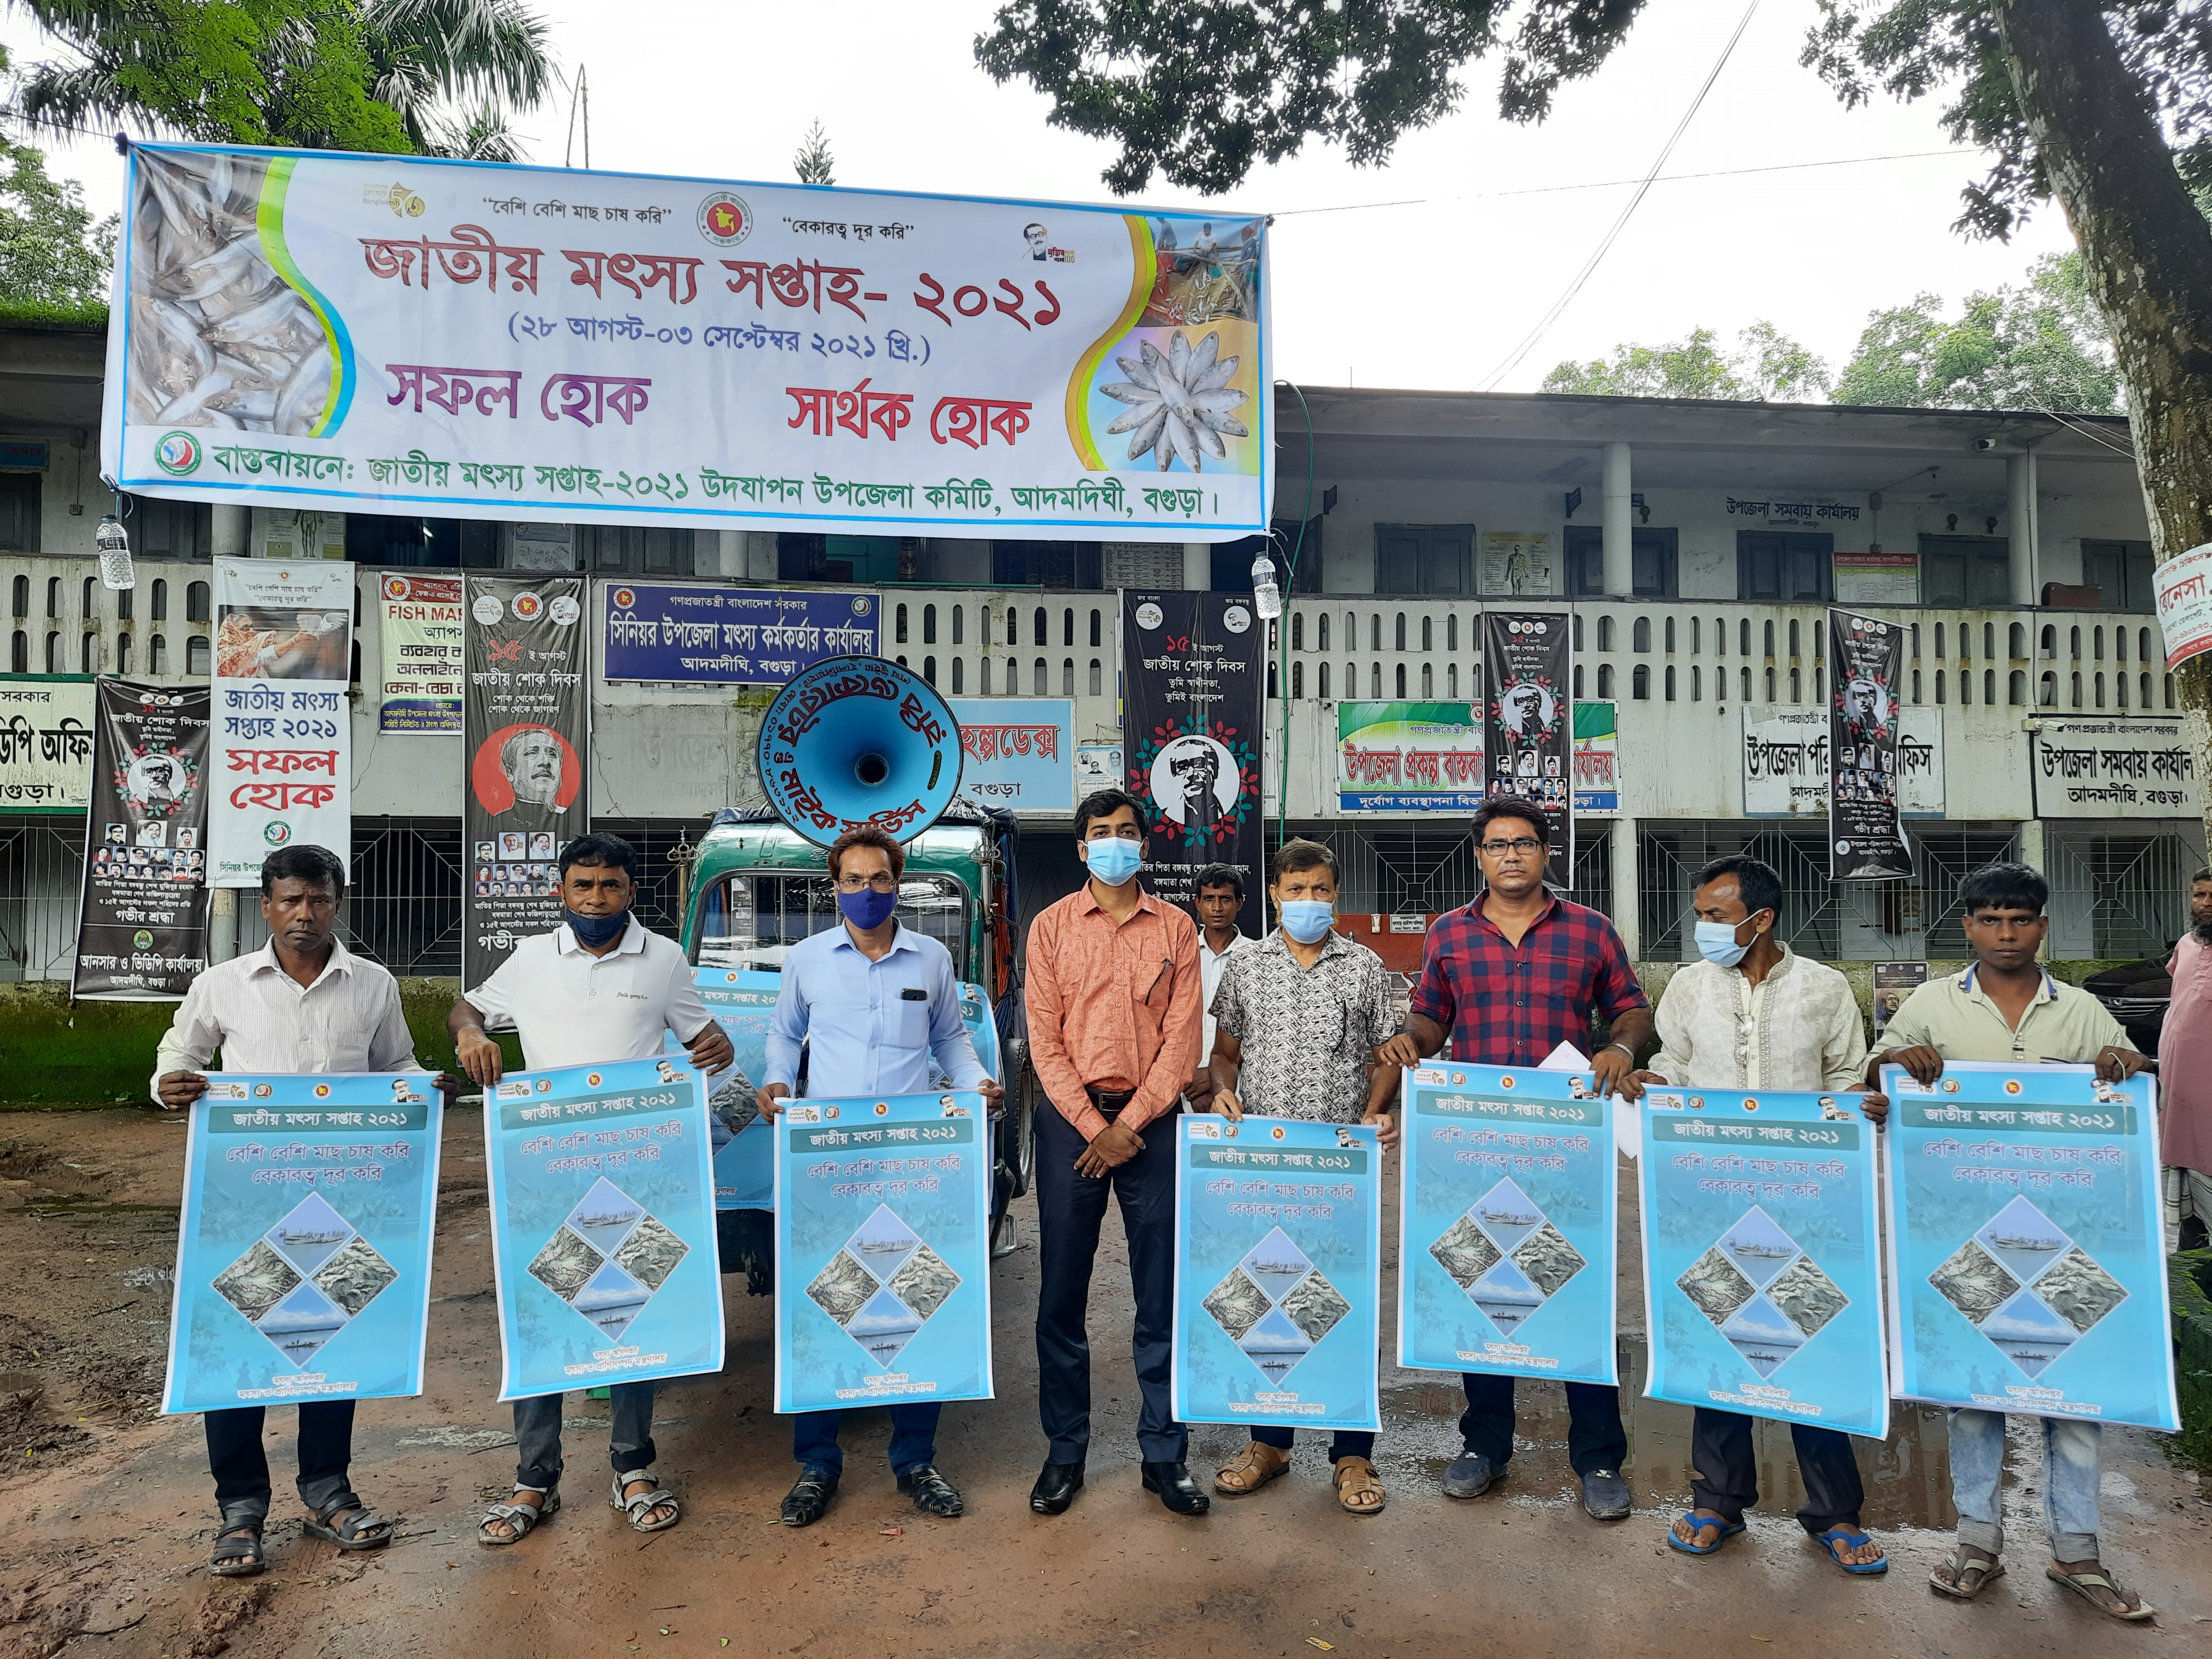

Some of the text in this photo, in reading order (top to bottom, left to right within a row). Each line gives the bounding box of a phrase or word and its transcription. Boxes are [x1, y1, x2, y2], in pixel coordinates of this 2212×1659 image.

[483, 196, 672, 225] “বেশি বেশি মাছ চাষ করি”
[700, 194, 749, 222] গণপ্রজাতন্ত্রী বাংলাদেশ
[783, 215, 914, 241] “বেকারত্ব দূর করি”
[713, 235, 741, 244] সরকার
[358, 225, 1061, 331] জাতীয় মৎস্য সপ্তাহ- ২০২১
[508, 310, 556, 341] (২৮
[569, 314, 692, 346] আগস্ট-০৩
[704, 321, 801, 354] সেপ্টেম্বর
[812, 332, 876, 360] ২০২১
[386, 364, 651, 428] সফল হোক
[786, 378, 1032, 450] সার্থক হোক
[212, 444, 353, 480] বাস্তবায়নে:
[366, 450, 448, 487] জাতীয়
[459, 462, 523, 491] মৎস্য
[535, 465, 688, 502] সপ্তাহ-২০২১
[702, 467, 803, 505] উদযাপন
[814, 473, 914, 510] উপজেলা
[925, 479, 1002, 516] কমিটি,
[1011, 477, 1134, 518] আদমদিঘী,
[1726, 497, 1860, 520] উপজেলা সমবায় কার্যালয়
[388, 606, 425, 620] FISH
[670, 595, 807, 611] গণপ্রজাতন্ত্রী বাংলাদেশ সরকার
[609, 611, 874, 655] সিনিয়র উপজেলা মৎস্য কর্মকর্তার কার্যালয়
[1166, 634, 1223, 653] ১৫ ই আগস্ট
[400, 645, 448, 659] ব্যবহার
[489, 639, 567, 662] ১৫ ই আগস্ট
[680, 654, 753, 675] আদমদীঘি,
[1142, 655, 1246, 674] জাতীয় শোক দিবস
[385, 682, 453, 694] কেনা-বেচা
[471, 667, 582, 688] জাতীয় শোক দিবস
[1169, 676, 1221, 690] তুমি স্বাধীনতা,
[1, 691, 51, 704] সরকার
[224, 684, 340, 713] জাতীয় মৎস্য
[493, 693, 555, 704] শোক থেকে শক্তি
[1165, 691, 1225, 704] তুমিই বাংলাদেশ
[109, 712, 210, 728] জাতীয় শোক দিবস
[488, 705, 559, 715] শোক থেকে জাগরণ
[778, 675, 899, 748] ডেকোরেটর
[225, 716, 337, 741] সপ্তাহ ২০২১
[1409, 722, 1464, 736] গণপ্রজাতন্ত্রী
[2118, 725, 2152, 734] বাংলাদেশ
[2154, 726, 2179, 736] সরকার
[959, 724, 1061, 764] হল্পডেক্স
[226, 749, 340, 776] সফল
[1343, 739, 1441, 787] উপজেলা প্রকল্প
[2041, 740, 2194, 781] উপজেলা সমবায় কার্যাল
[230, 783, 336, 811] হোক
[780, 767, 838, 830] মাইক
[969, 782, 1022, 798] বগুড়া
[1359, 795, 1455, 809] দুর্যোগ ব্যবস্থাপনা
[115, 908, 176, 924] গভীর শ্রদ্ধা
[79, 952, 204, 973] আনসার ও ভিডিপি কার্যালয়
[232, 1108, 408, 1128] জাতীয় মৎস্য সপ্তাহ ২০২১
[1923, 1105, 2114, 1129] জাতীয় মৎস্য সপ্তাহ ২০২১
[227, 1140, 412, 1162] বেশি বেশি মাছ চাষ করি
[1209, 1148, 1350, 1170] জাতীয় মৎস্য সপ্তাহ ২০২১
[1923, 1138, 2124, 1165] বেশি বেশি মাছ চাষ করি
[252, 1162, 384, 1186] বেকারত্ব দূর করি
[1953, 1166, 2096, 1190] বেকারত্ব দূর করি
